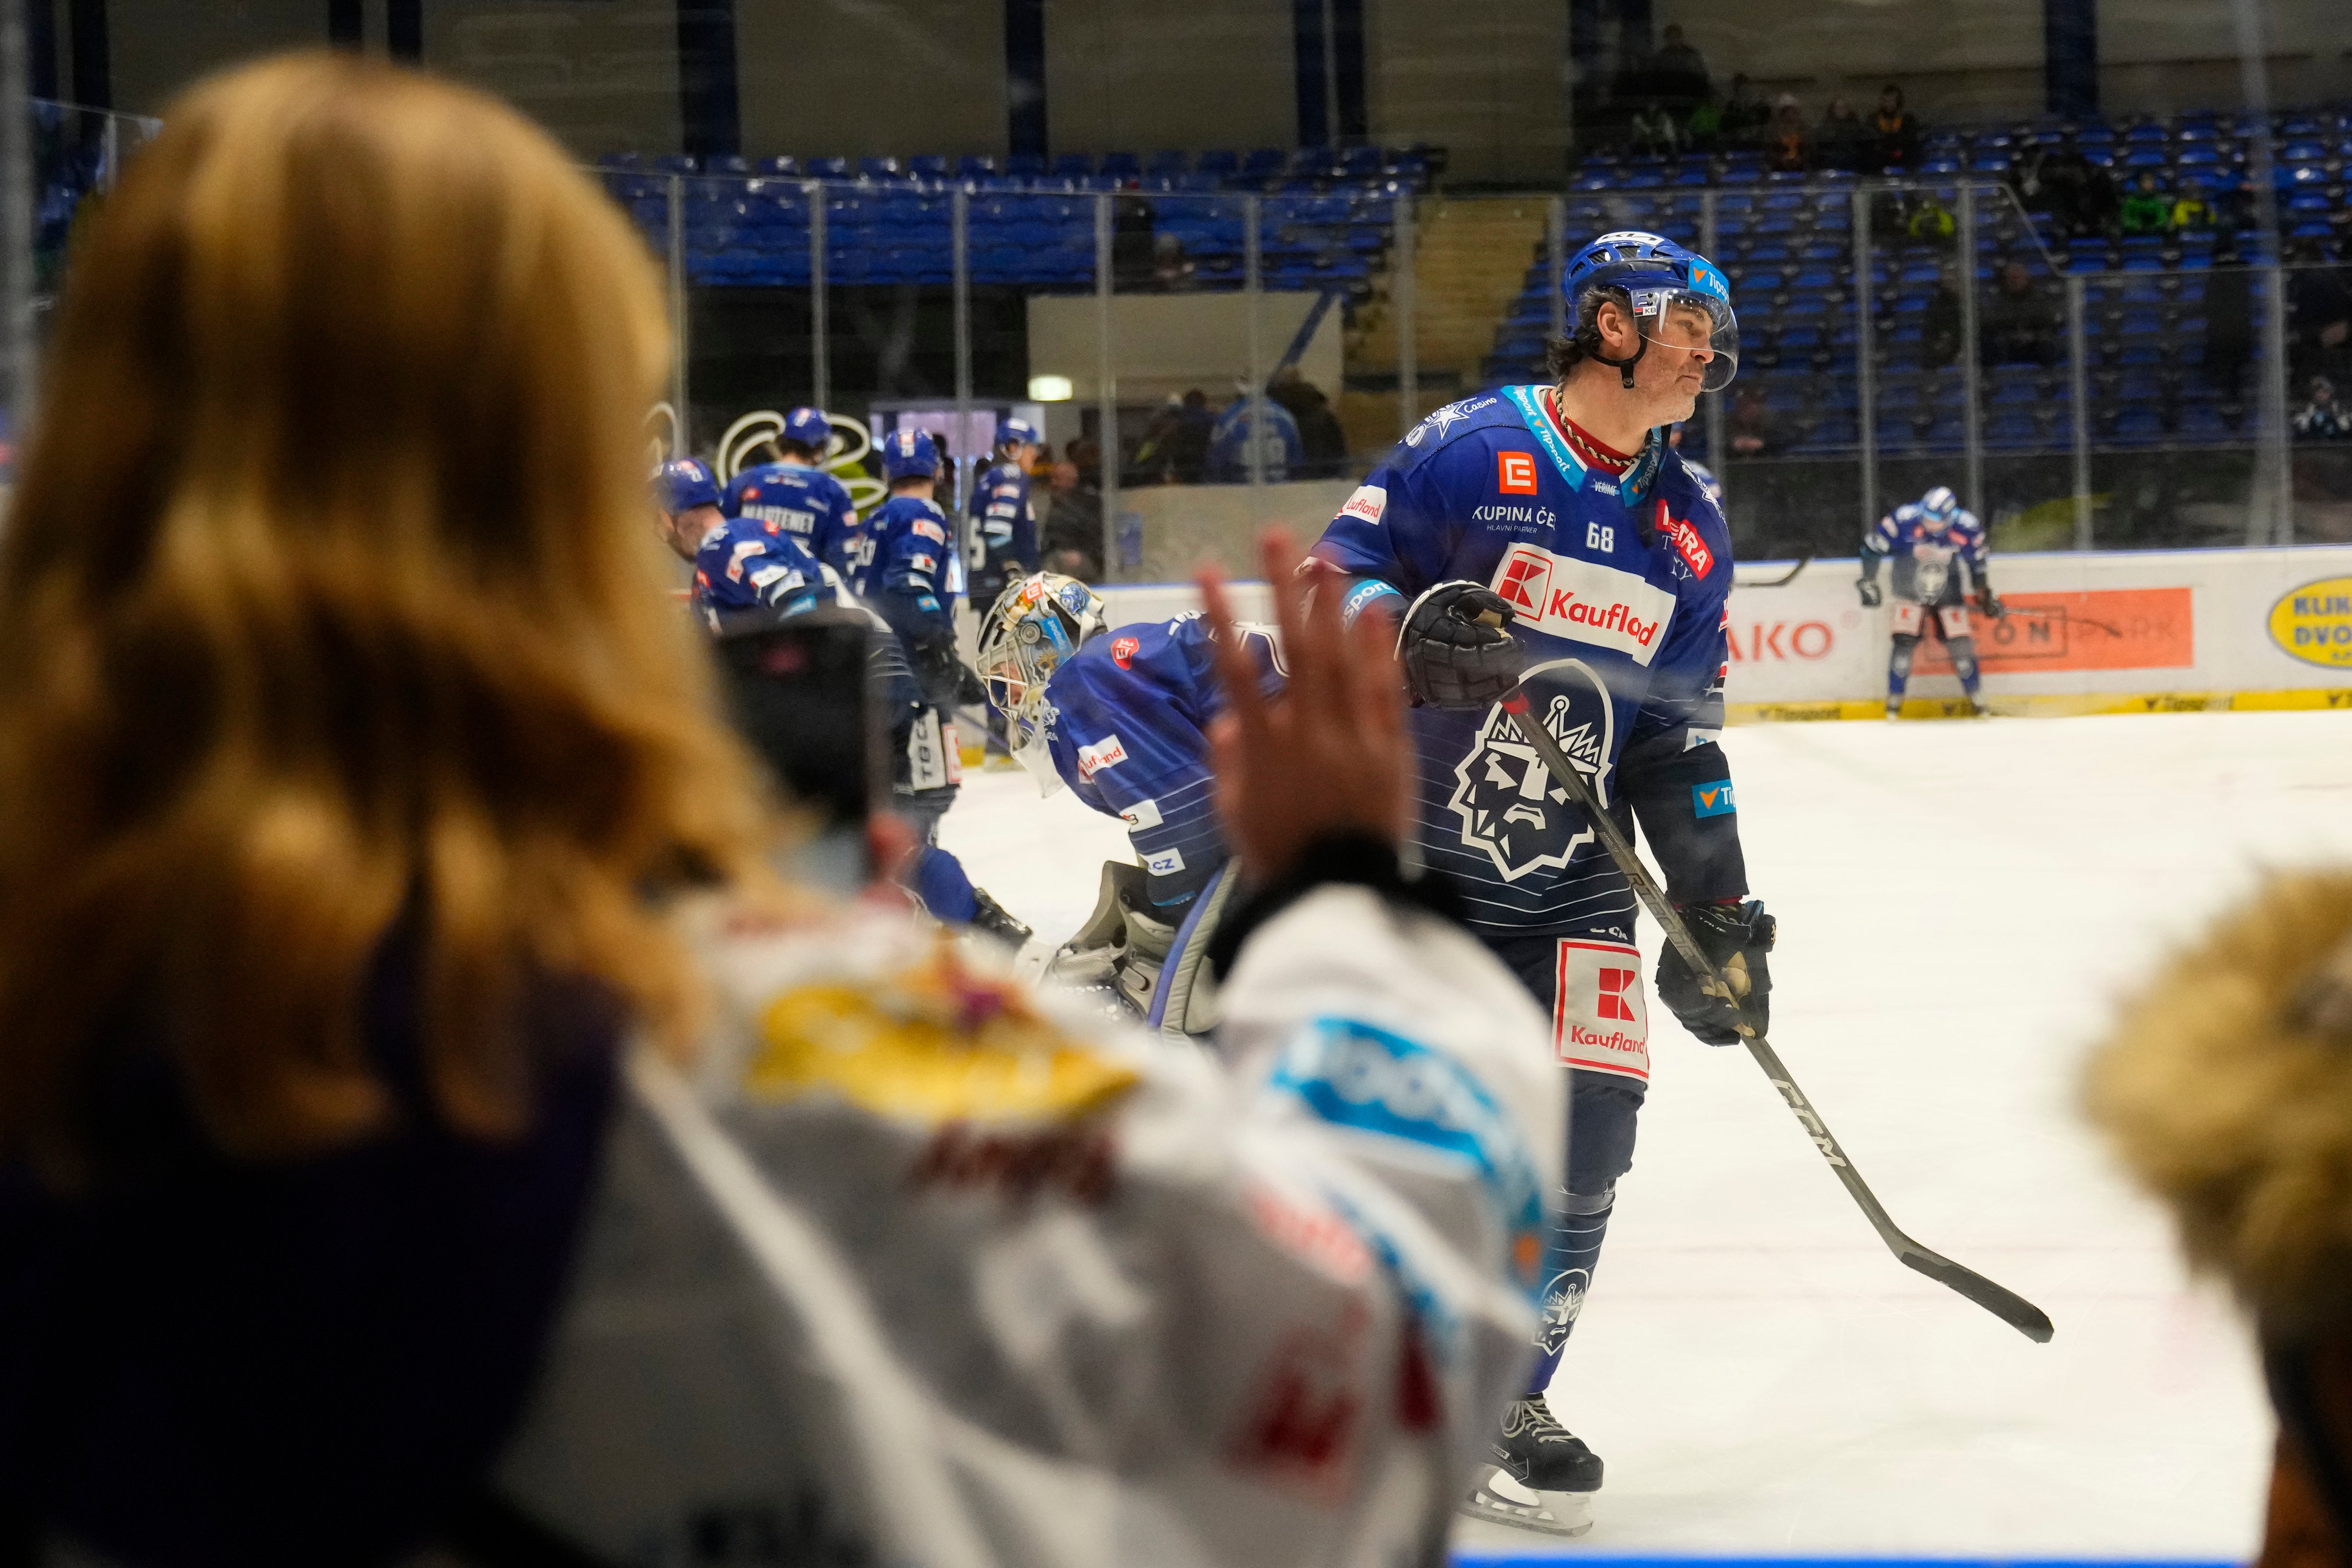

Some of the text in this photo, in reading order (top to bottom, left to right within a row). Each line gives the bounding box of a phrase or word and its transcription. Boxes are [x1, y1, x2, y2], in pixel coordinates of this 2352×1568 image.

[1464, 397, 1497, 413] Casino
[1540, 429, 1570, 472] Tipsport
[1536, 506, 1556, 531] ČE
[1585, 521, 1614, 553] 68
[1571, 1025, 1644, 1054] Kaufland
[1771, 1078, 1847, 1167] CCM
